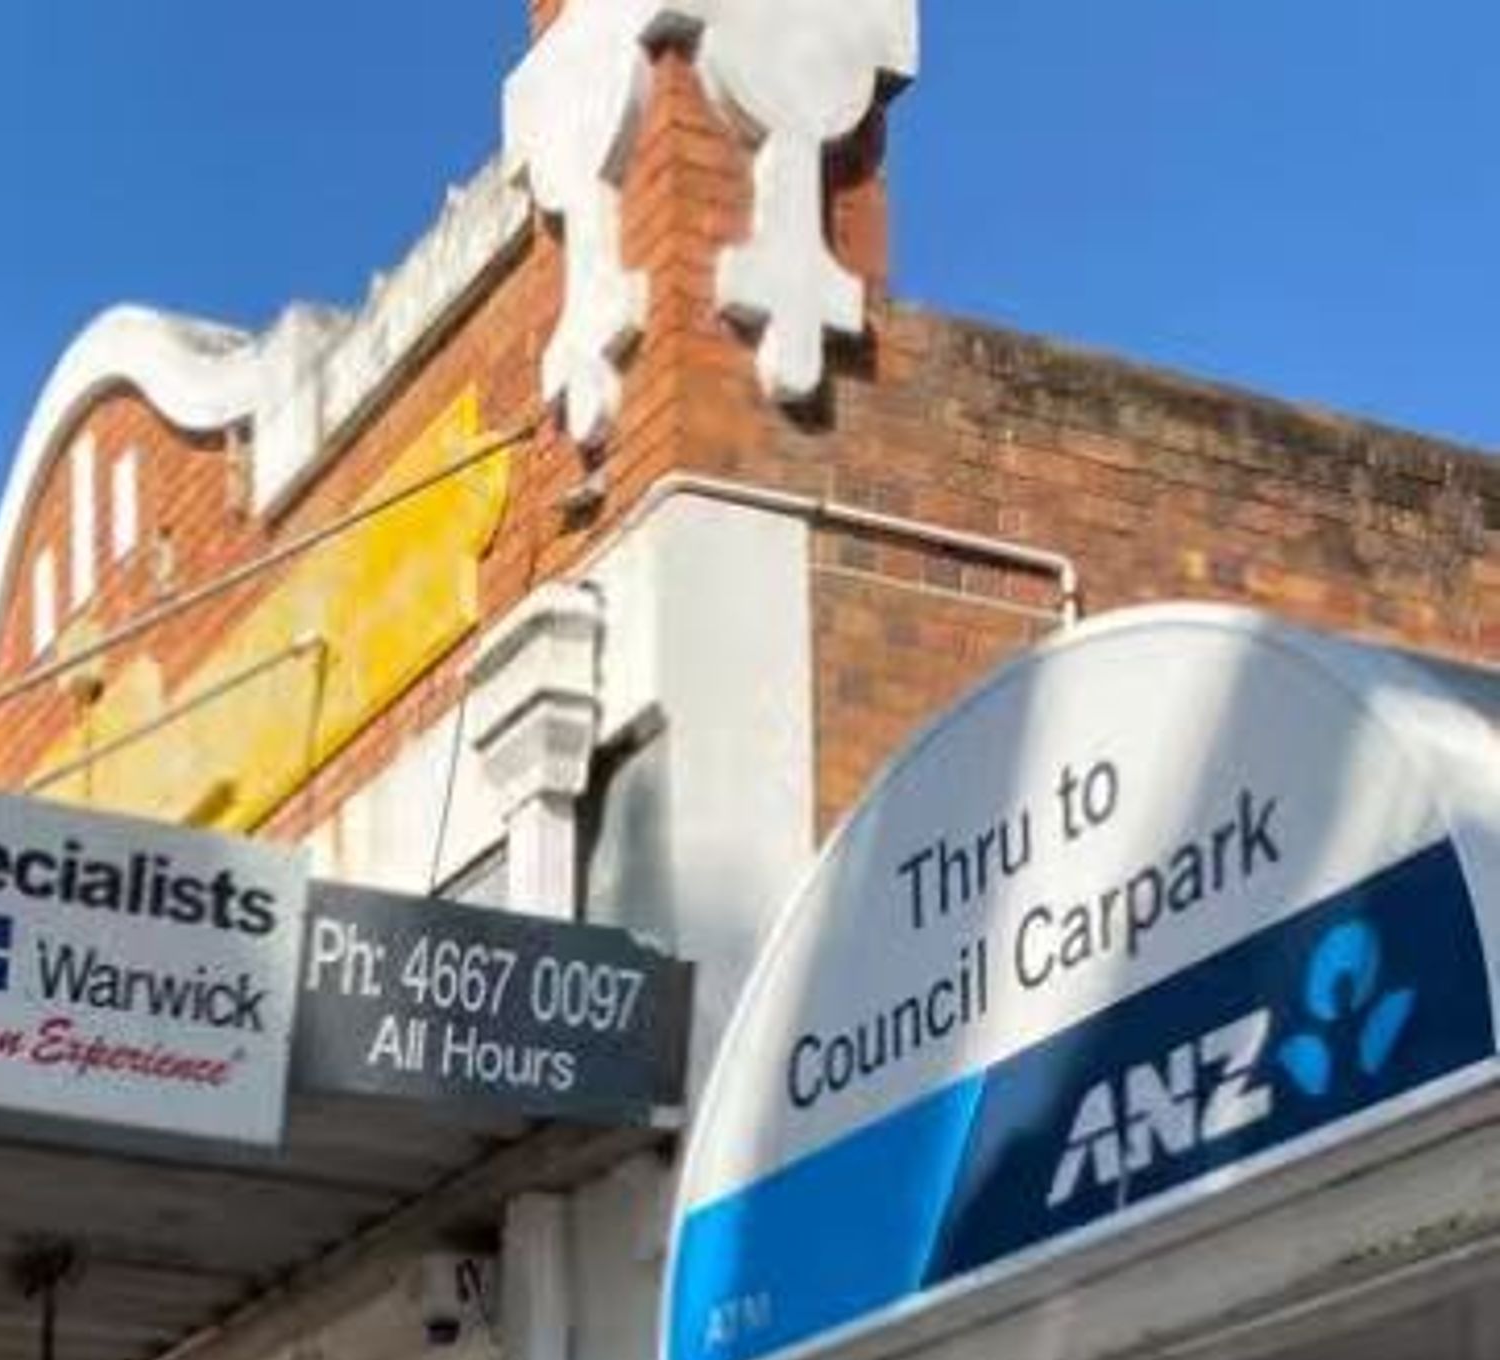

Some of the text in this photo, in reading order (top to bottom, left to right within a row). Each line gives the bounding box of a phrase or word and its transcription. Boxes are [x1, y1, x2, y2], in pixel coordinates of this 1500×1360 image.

[899, 758, 1121, 930] Thru to
[36, 938, 268, 1032] Warwick
[306, 919, 645, 1032] Ph: 4667 0097
[786, 792, 1280, 1109] Council Carpark
[369, 1015, 577, 1093] All Hours
[1046, 1008, 1273, 1207] ANZ
